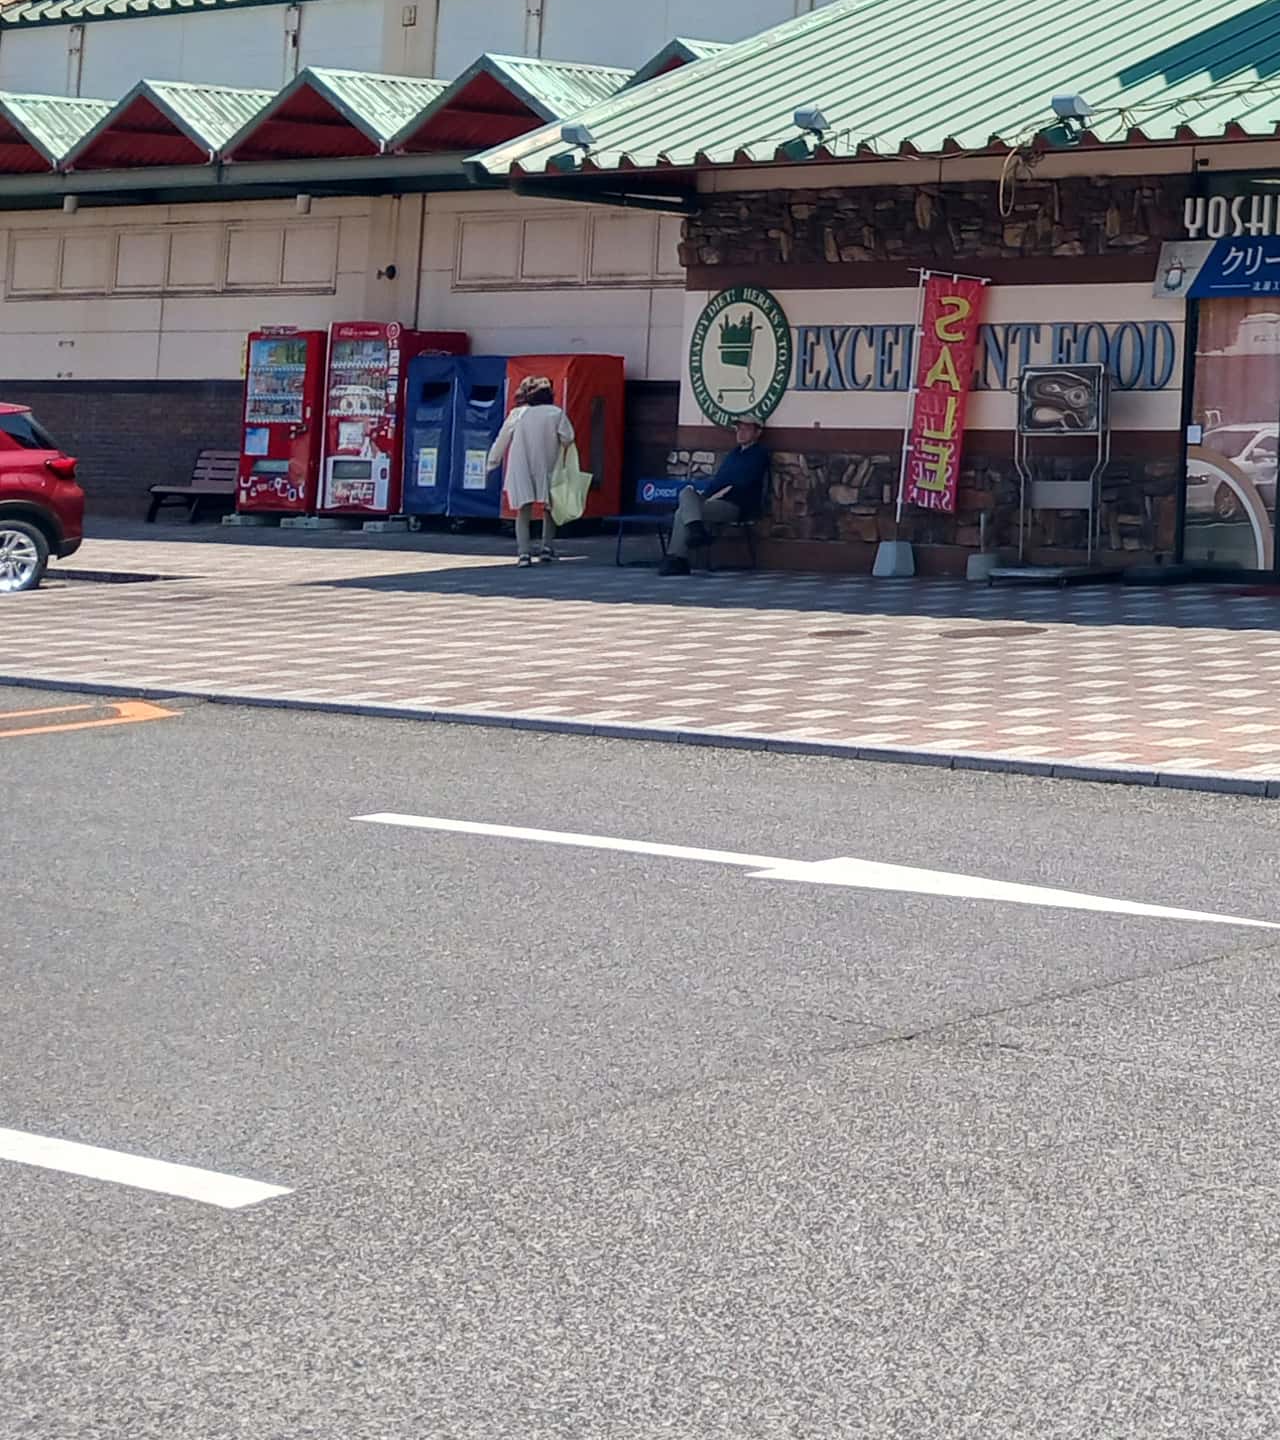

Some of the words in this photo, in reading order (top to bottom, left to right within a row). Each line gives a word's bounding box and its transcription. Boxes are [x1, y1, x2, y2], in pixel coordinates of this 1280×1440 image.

[743, 287, 771, 314] HERE
[773, 338, 789, 392] TOAST
[795, 324, 1041, 391] EXCENT
